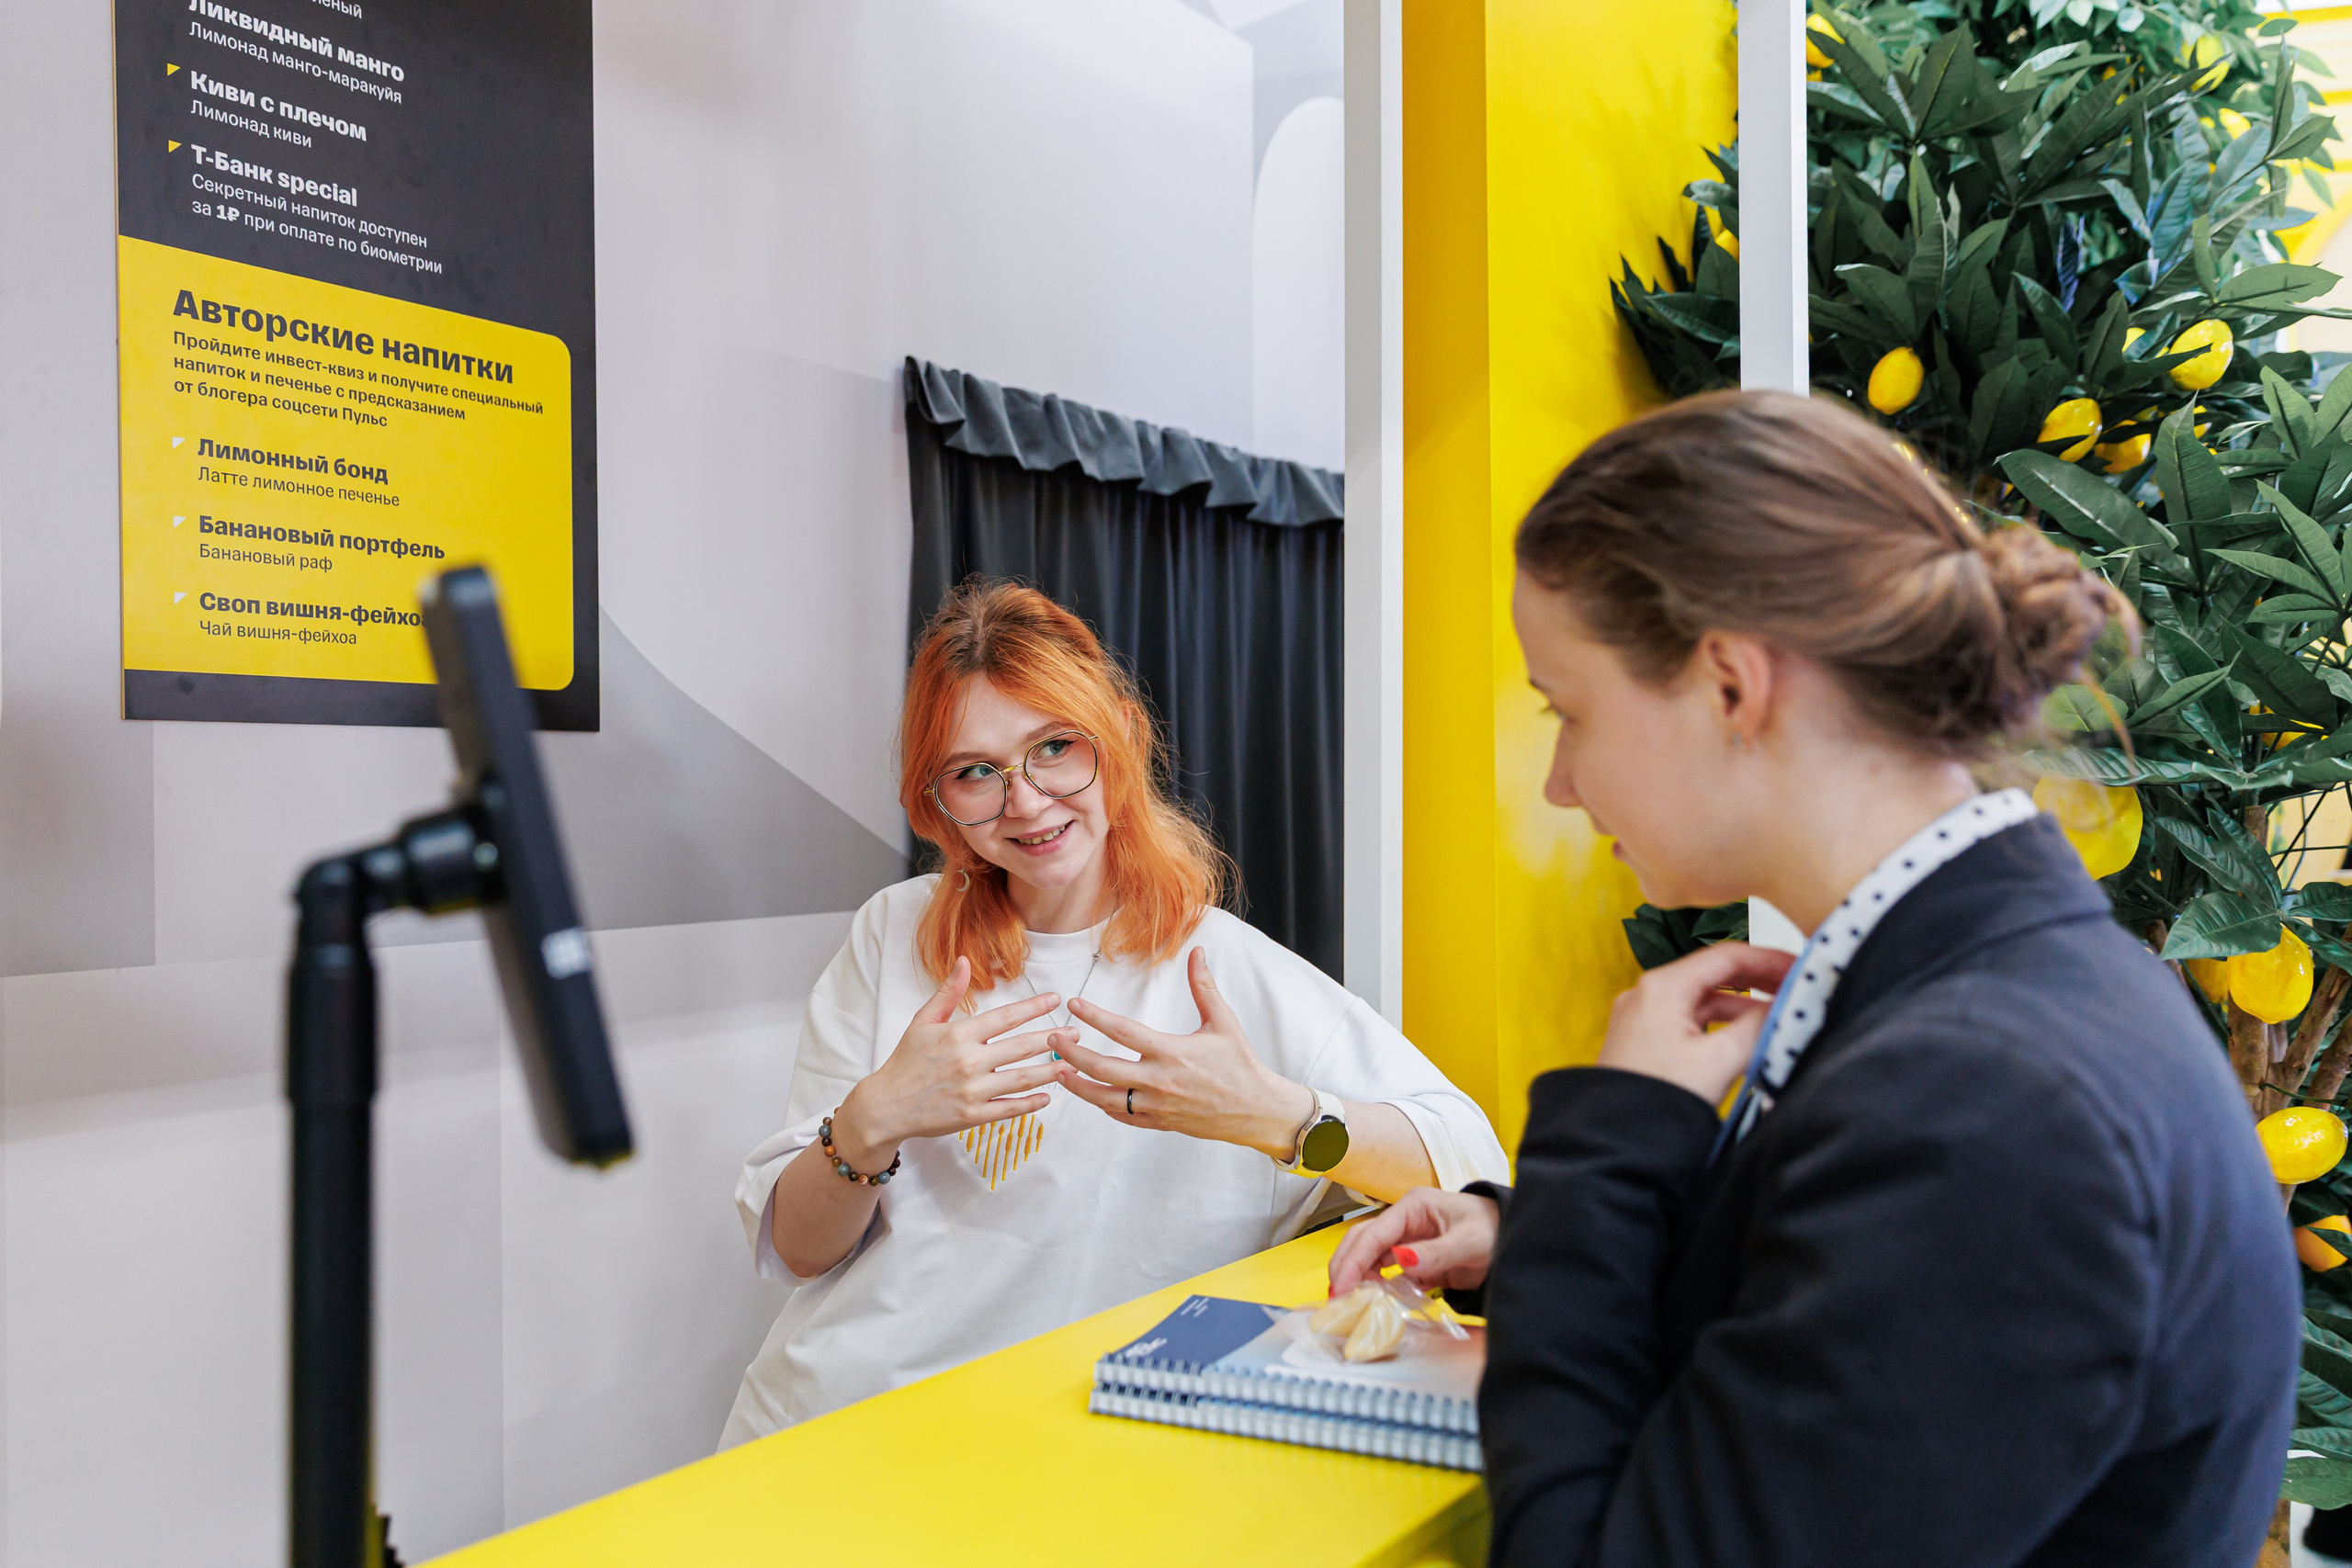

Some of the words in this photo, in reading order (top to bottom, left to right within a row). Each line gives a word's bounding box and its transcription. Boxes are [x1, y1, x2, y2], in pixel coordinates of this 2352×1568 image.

[188, 0, 333, 59] Ликвидный
[337, 46, 405, 82] манго
[188, 21, 269, 63] Лимонад
[272, 51, 402, 105] манго-маракуйя
[190, 70, 255, 107] Киви
[260, 96, 275, 113] с
[279, 101, 368, 142] плечом
[190, 99, 270, 139] Лимонад
[273, 126, 311, 149] киви
[190, 143, 274, 185] Т-Банк
[277, 172, 357, 208] special
[192, 173, 288, 212] Секретный
[291, 201, 356, 230] напиток
[358, 220, 427, 249] доступен
[192, 200, 212, 217] за
[244, 213, 275, 232] при
[278, 222, 334, 247] оплате
[338, 237, 357, 253] по
[360, 240, 442, 275] биометрии
[173, 289, 374, 355] Авторские
[382, 337, 513, 384] напитки
[174, 331, 261, 360] Пройдите
[266, 351, 365, 380] инвест-квиз
[368, 371, 378, 382] и
[381, 374, 448, 396] получите
[451, 388, 543, 414] специальный
[174, 356, 246, 380] напиток
[251, 371, 260, 383] и
[266, 374, 332, 396] печенье
[335, 387, 345, 398] с
[348, 389, 466, 420] предсказанием
[174, 380, 194, 394] от
[198, 381, 267, 408] блогера
[272, 398, 338, 419] соцсети
[343, 407, 388, 427] Пульс
[198, 438, 329, 474] Лимонный
[334, 457, 389, 486] бонд
[198, 466, 248, 487] Латте
[252, 477, 334, 498] лимонное
[338, 488, 400, 507] печенье
[199, 514, 334, 547] Банановый
[339, 535, 446, 559] портфель
[199, 543, 295, 567] Банановый
[300, 556, 333, 573] раф
[199, 592, 260, 615] Своп
[199, 620, 232, 637] Чай
[237, 626, 356, 645] вишня-фейхоа
